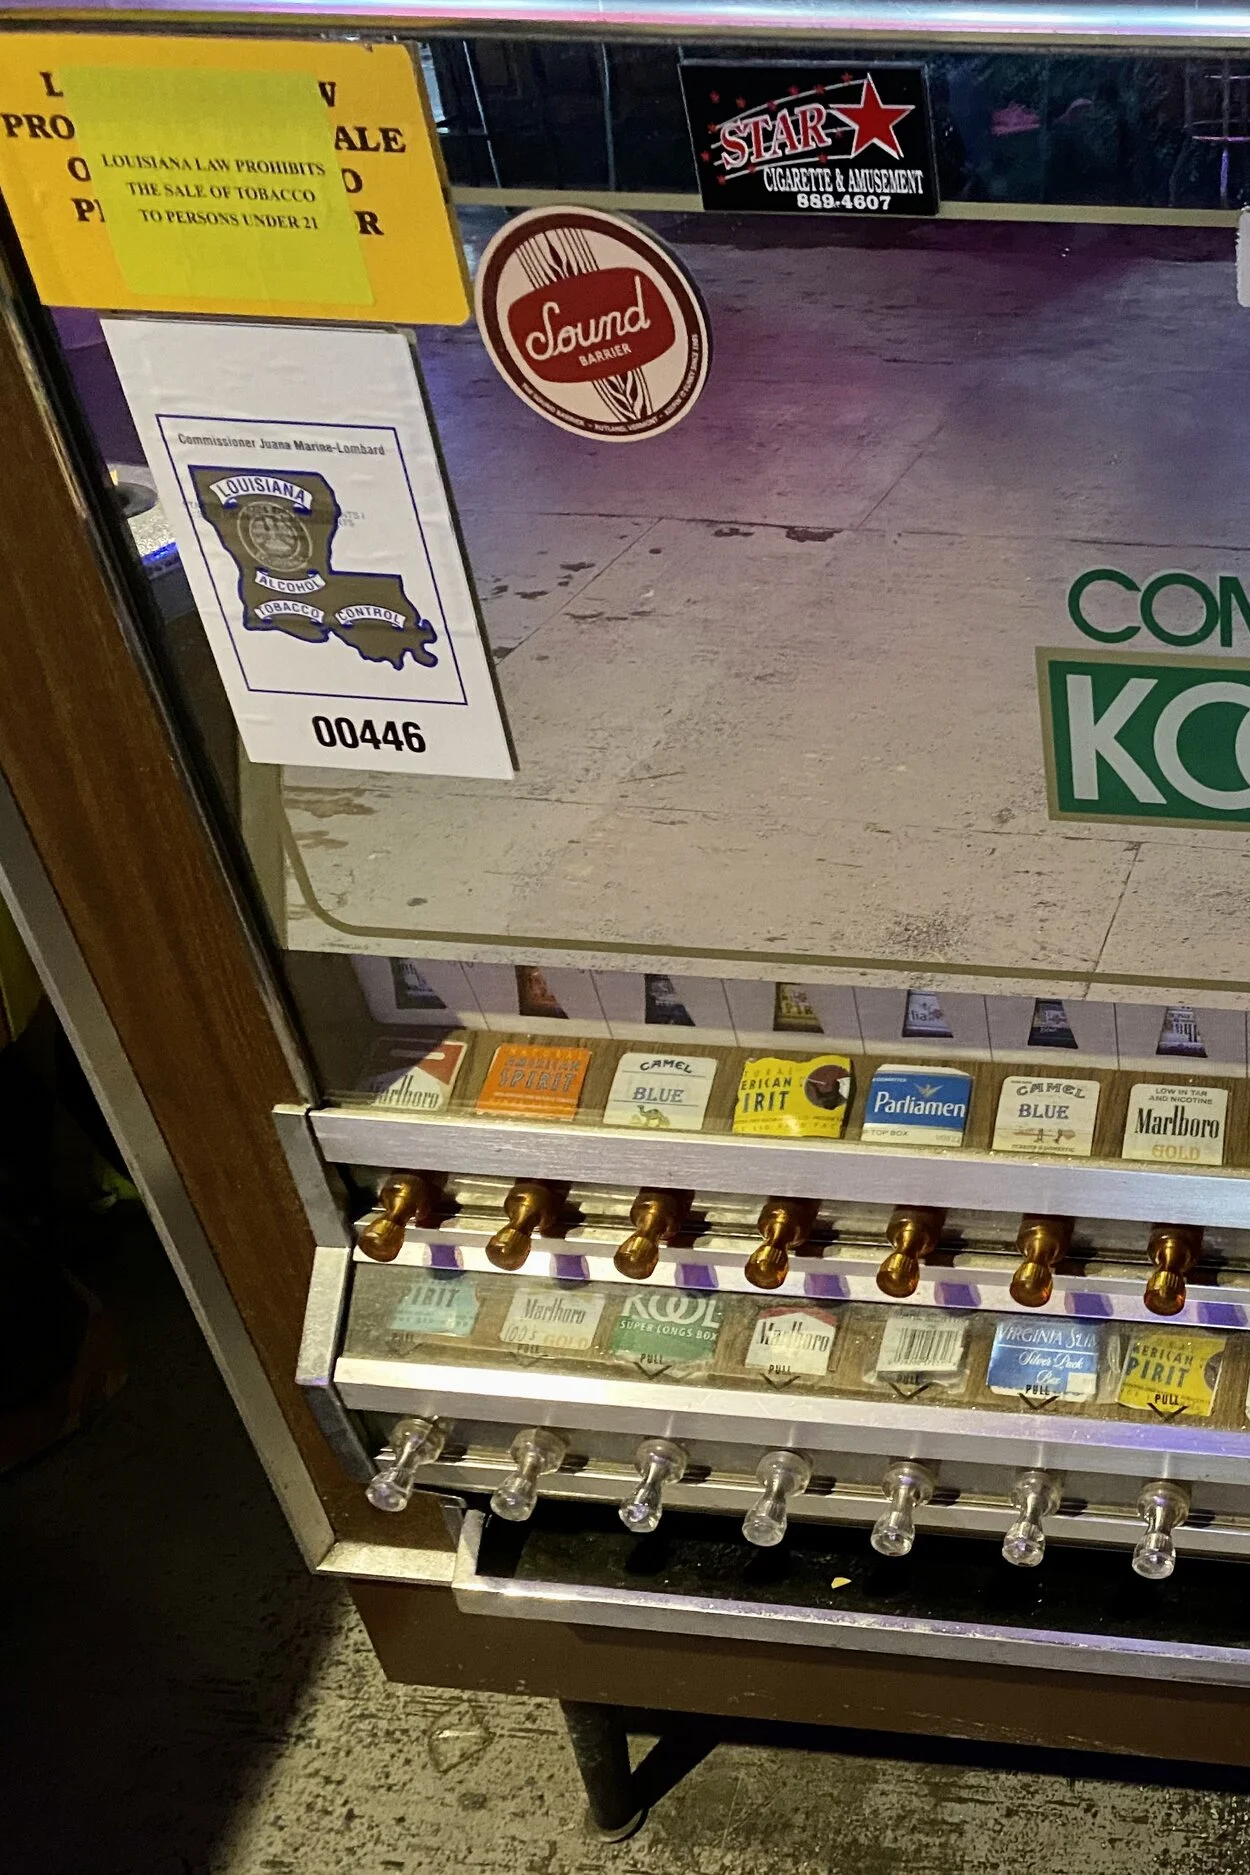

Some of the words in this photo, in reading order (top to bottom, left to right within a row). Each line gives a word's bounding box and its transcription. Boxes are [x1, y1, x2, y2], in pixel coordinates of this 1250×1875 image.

[719, 103, 832, 170] STAR
[101, 153, 193, 171] LOUISIANA
[195, 156, 230, 172] LAW
[235, 158, 326, 176] PROHIBITS
[763, 167, 832, 192] CIGARETTE
[835, 168, 847, 191] &
[848, 169, 924, 194] AMUSEMENT
[126, 181, 160, 196] THE
[164, 184, 202, 199] SALE
[209, 186, 232, 199] OF
[236, 186, 316, 203] TOBACCO
[797, 194, 891, 210] 889-4607
[138, 208, 163, 222] TO
[164, 209, 239, 225] PERSONS
[242, 214, 300, 229] UNDER
[303, 217, 319, 230] 21
[525, 275, 651, 361] Sound
[578, 342, 632, 367] BARRIER
[178, 434, 256, 448] Commissioner
[260, 439, 292, 450] Juana
[293, 440, 385, 455] Marine-Lombard
[216, 478, 305, 503] LOUISIANA
[260, 575, 321, 592] ALCOHOL
[260, 602, 320, 619] TOBACCO
[337, 609, 400, 625] CONTROL
[312, 716, 426, 753] 00446
[640, 1060, 693, 1074] CAMEL
[741, 1077, 792, 1091] ERICAN
[1016, 1083, 1085, 1099] CAMEL
[632, 1087, 684, 1103] BLUE
[743, 1090, 790, 1114] IRIT
[874, 1092, 966, 1118] Parliamen
[1170, 1097, 1213, 1105] NICOTINE
[1018, 1103, 1070, 1120] BLUE
[1134, 1105, 1220, 1139] Marlboro
[1152, 1144, 1200, 1161] GOLD
[523, 1298, 586, 1325] Marlboro
[620, 1294, 720, 1329] KOOL
[619, 1320, 654, 1333] SUPER
[656, 1325, 693, 1338] LONGS
[695, 1331, 718, 1341] BOX
[756, 1321, 830, 1353] Marlboro
[998, 1324, 1063, 1346] VIRGINIA
[640, 1353, 663, 1365] PULL
[1018, 1351, 1051, 1367] Silver
[1052, 1353, 1084, 1370] Pack
[768, 1364, 792, 1376] PULL
[1126, 1356, 1190, 1389] PIRIT
[1025, 1384, 1050, 1395] PULL
[1155, 1394, 1180, 1406] PULL
